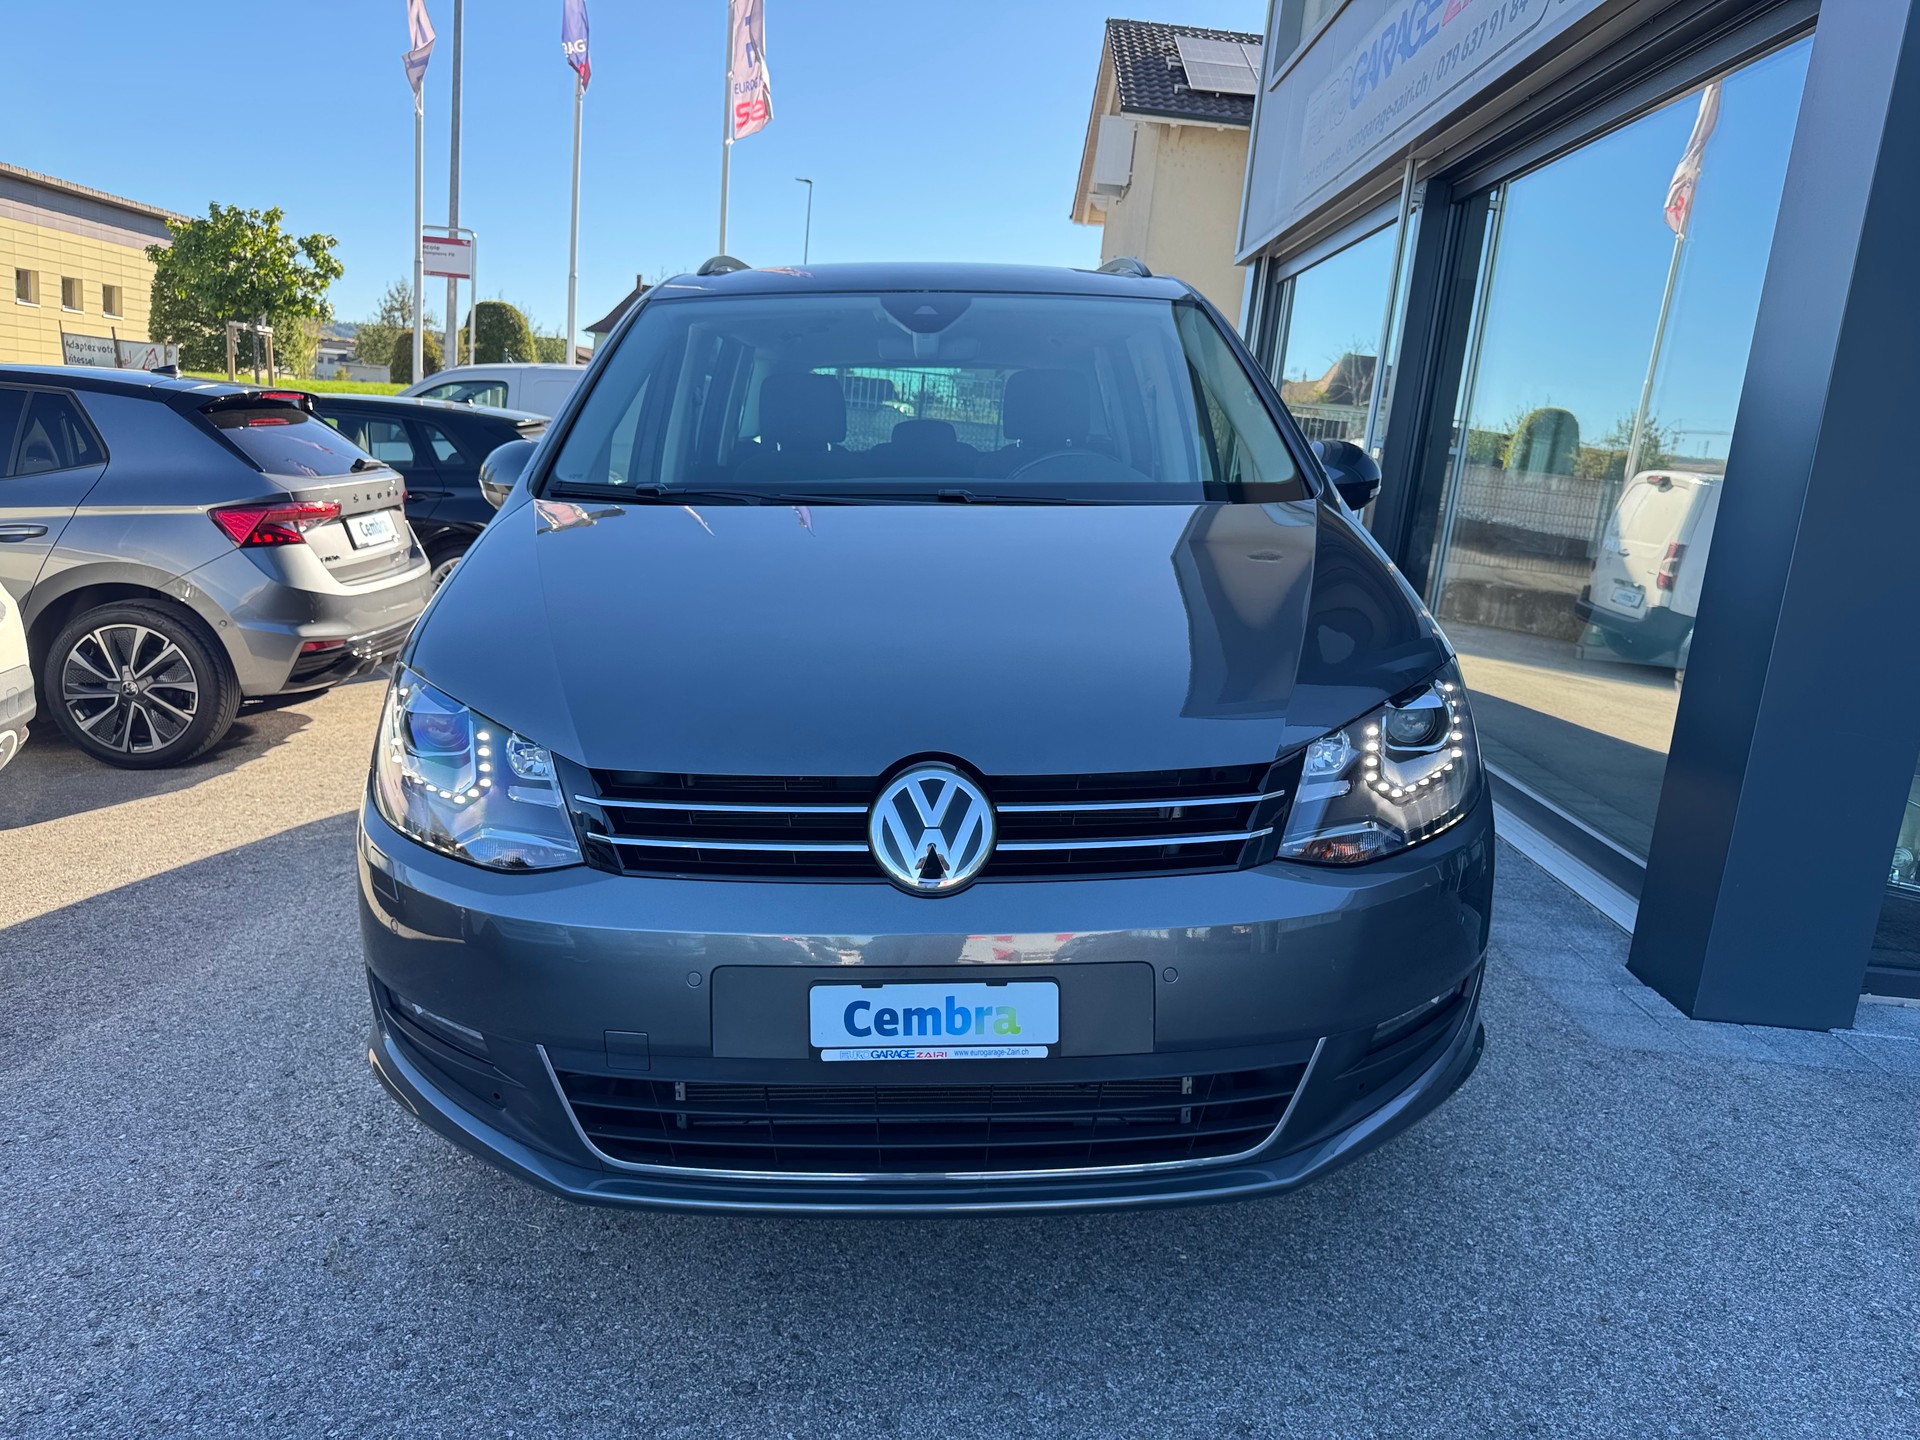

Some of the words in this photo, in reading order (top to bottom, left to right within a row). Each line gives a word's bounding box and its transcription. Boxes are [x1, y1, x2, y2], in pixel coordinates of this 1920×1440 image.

[1437, 42, 1460, 81] 079
[1461, 19, 1488, 62] 637
[1489, 2, 1508, 40] 91
[843, 995, 1021, 1038] Cembra
[916, 1051, 948, 1059] ZAIRI
